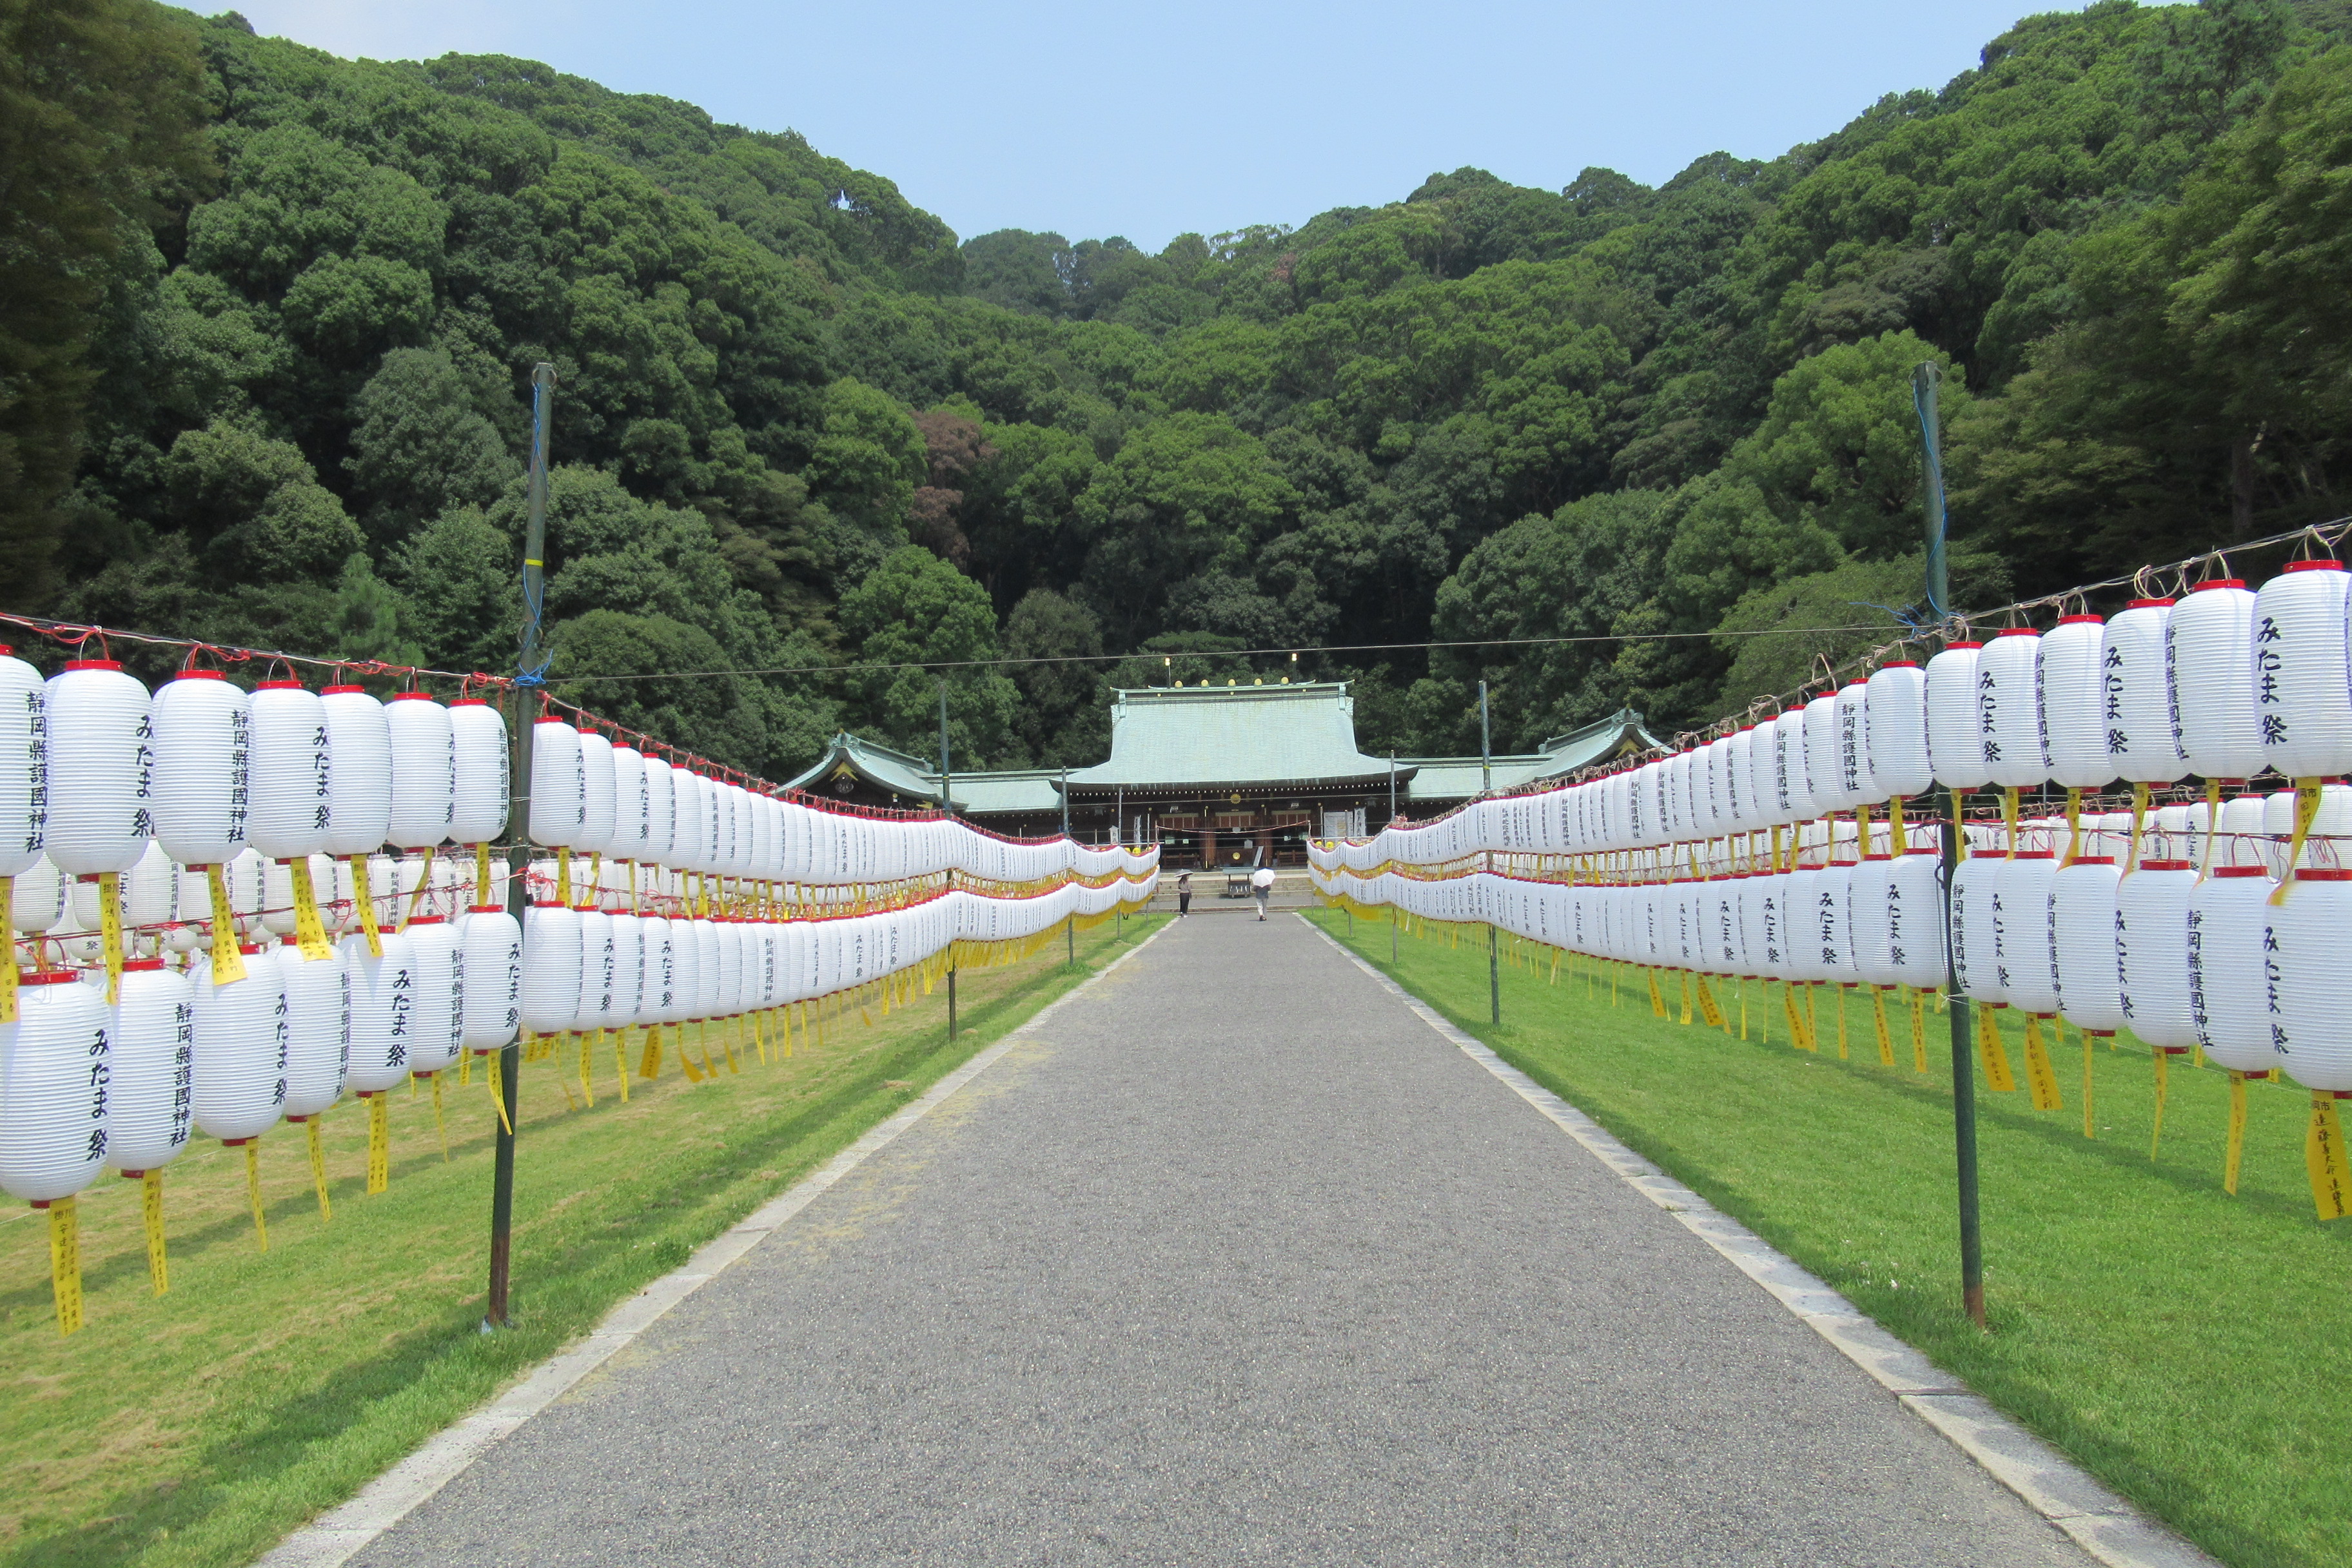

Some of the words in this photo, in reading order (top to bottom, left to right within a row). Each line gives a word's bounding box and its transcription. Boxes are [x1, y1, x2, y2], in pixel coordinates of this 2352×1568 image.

[1979, 671, 2001, 762] みたま祭
[2104, 647, 2128, 754] みたま祭
[2257, 617, 2288, 745] みたま祭
[131, 714, 153, 838] みたま祭
[313, 727, 329, 829] みたま祭
[1720, 901, 1734, 961] みたま祭
[1764, 897, 1779, 963] みたま祭
[1819, 892, 1837, 965] みたま祭
[1887, 884, 1905, 965] みたま祭
[387, 969, 411, 1067] みたま祭
[505, 943, 521, 1028] みたま祭
[600, 937, 614, 1011] みたま祭
[661, 940, 672, 1007] みたま祭
[272, 994, 288, 1105] みたま祭
[87, 1030, 110, 1161] みたま祭
